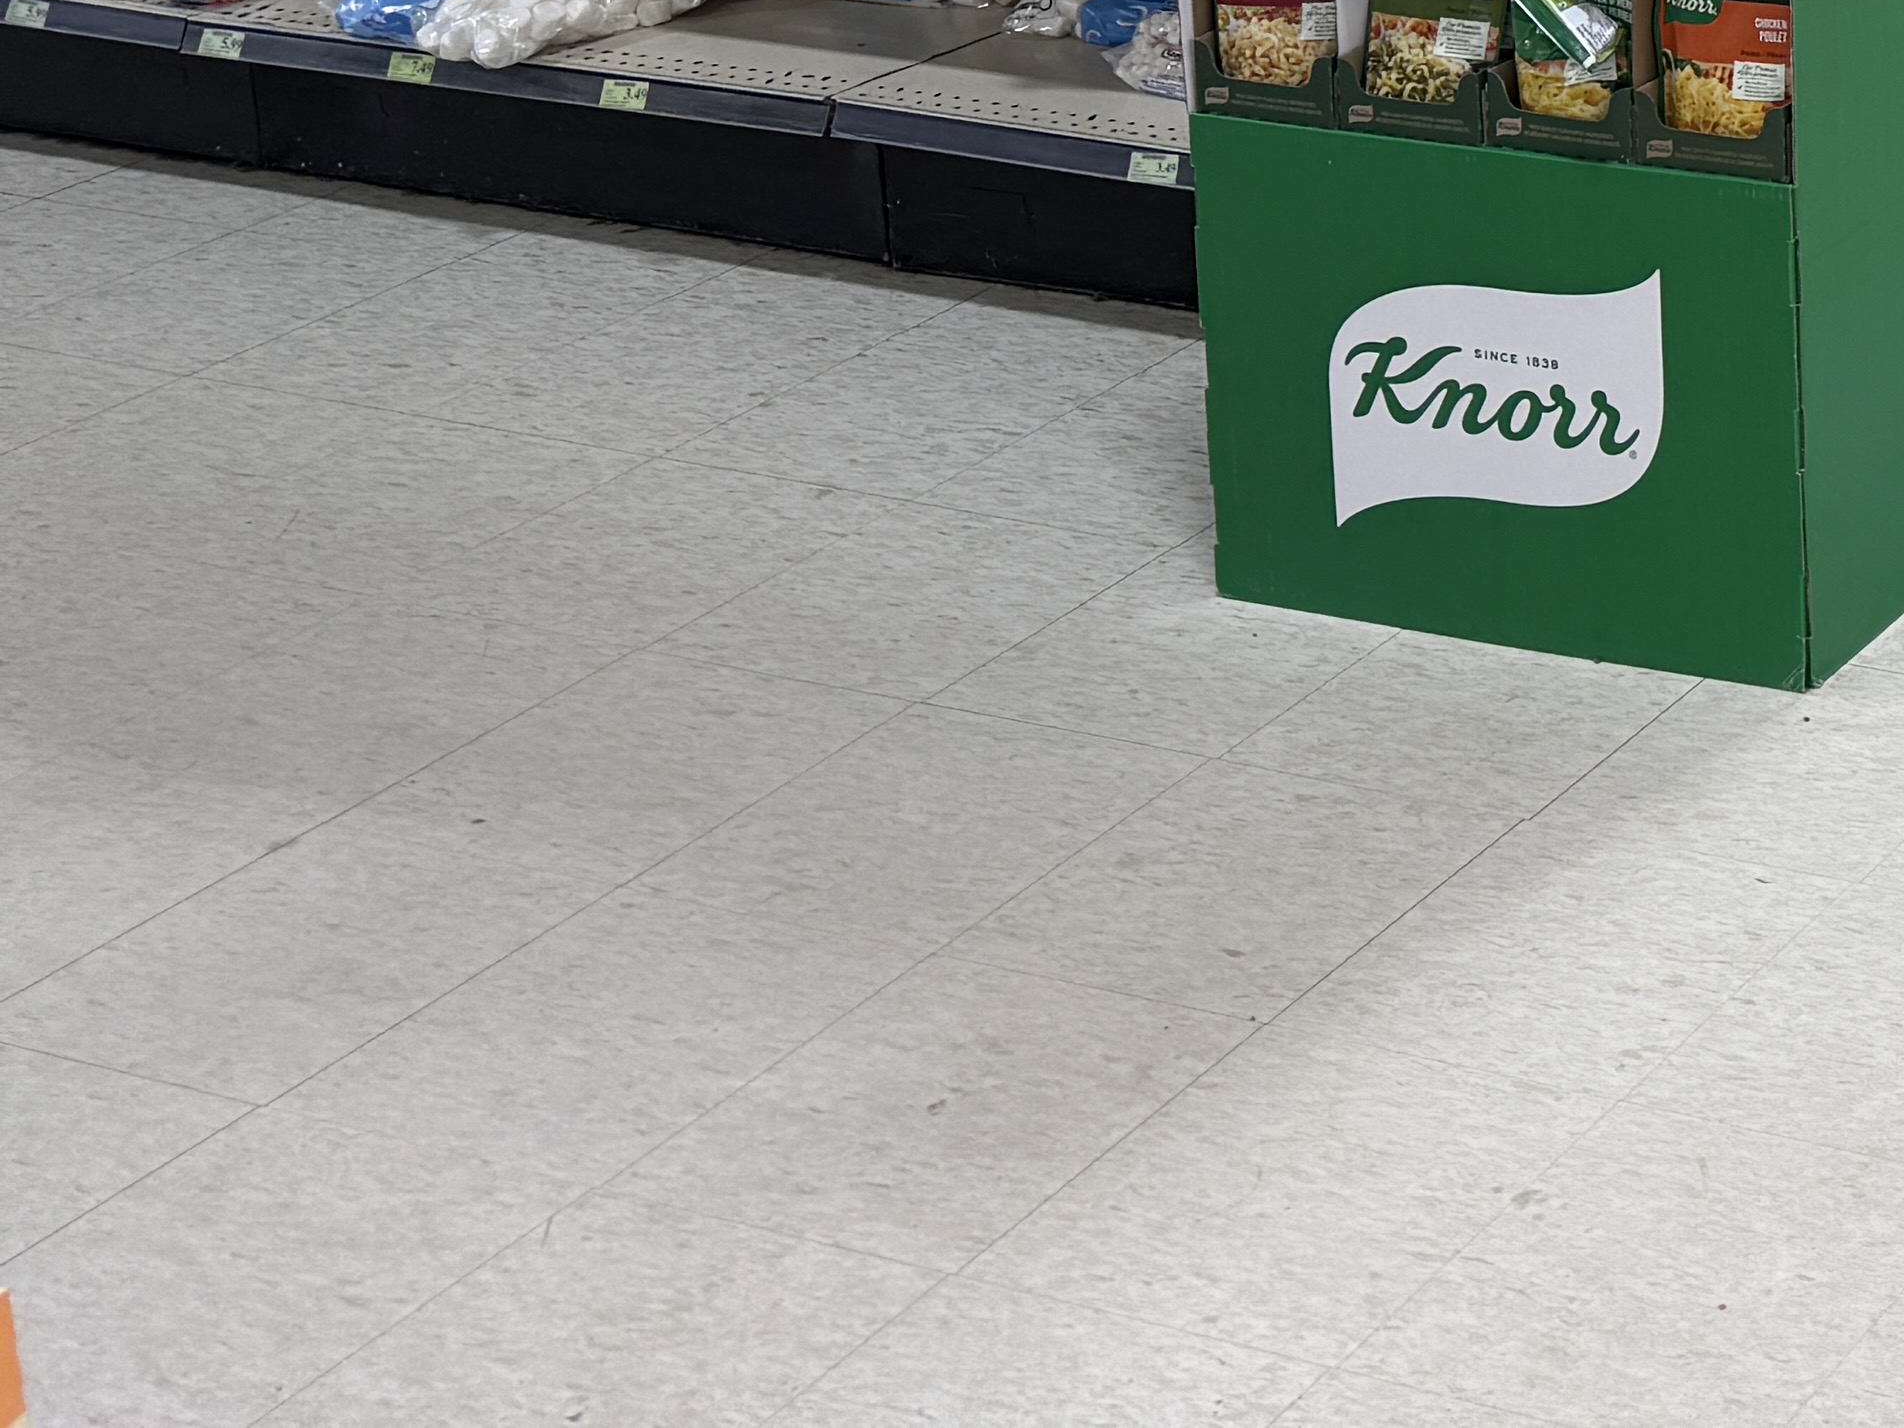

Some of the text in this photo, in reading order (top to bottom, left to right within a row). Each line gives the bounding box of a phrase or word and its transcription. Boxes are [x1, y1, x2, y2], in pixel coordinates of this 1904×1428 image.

[1474, 348, 1560, 370] SINCE 1838
[1344, 336, 1641, 456] Knorr
